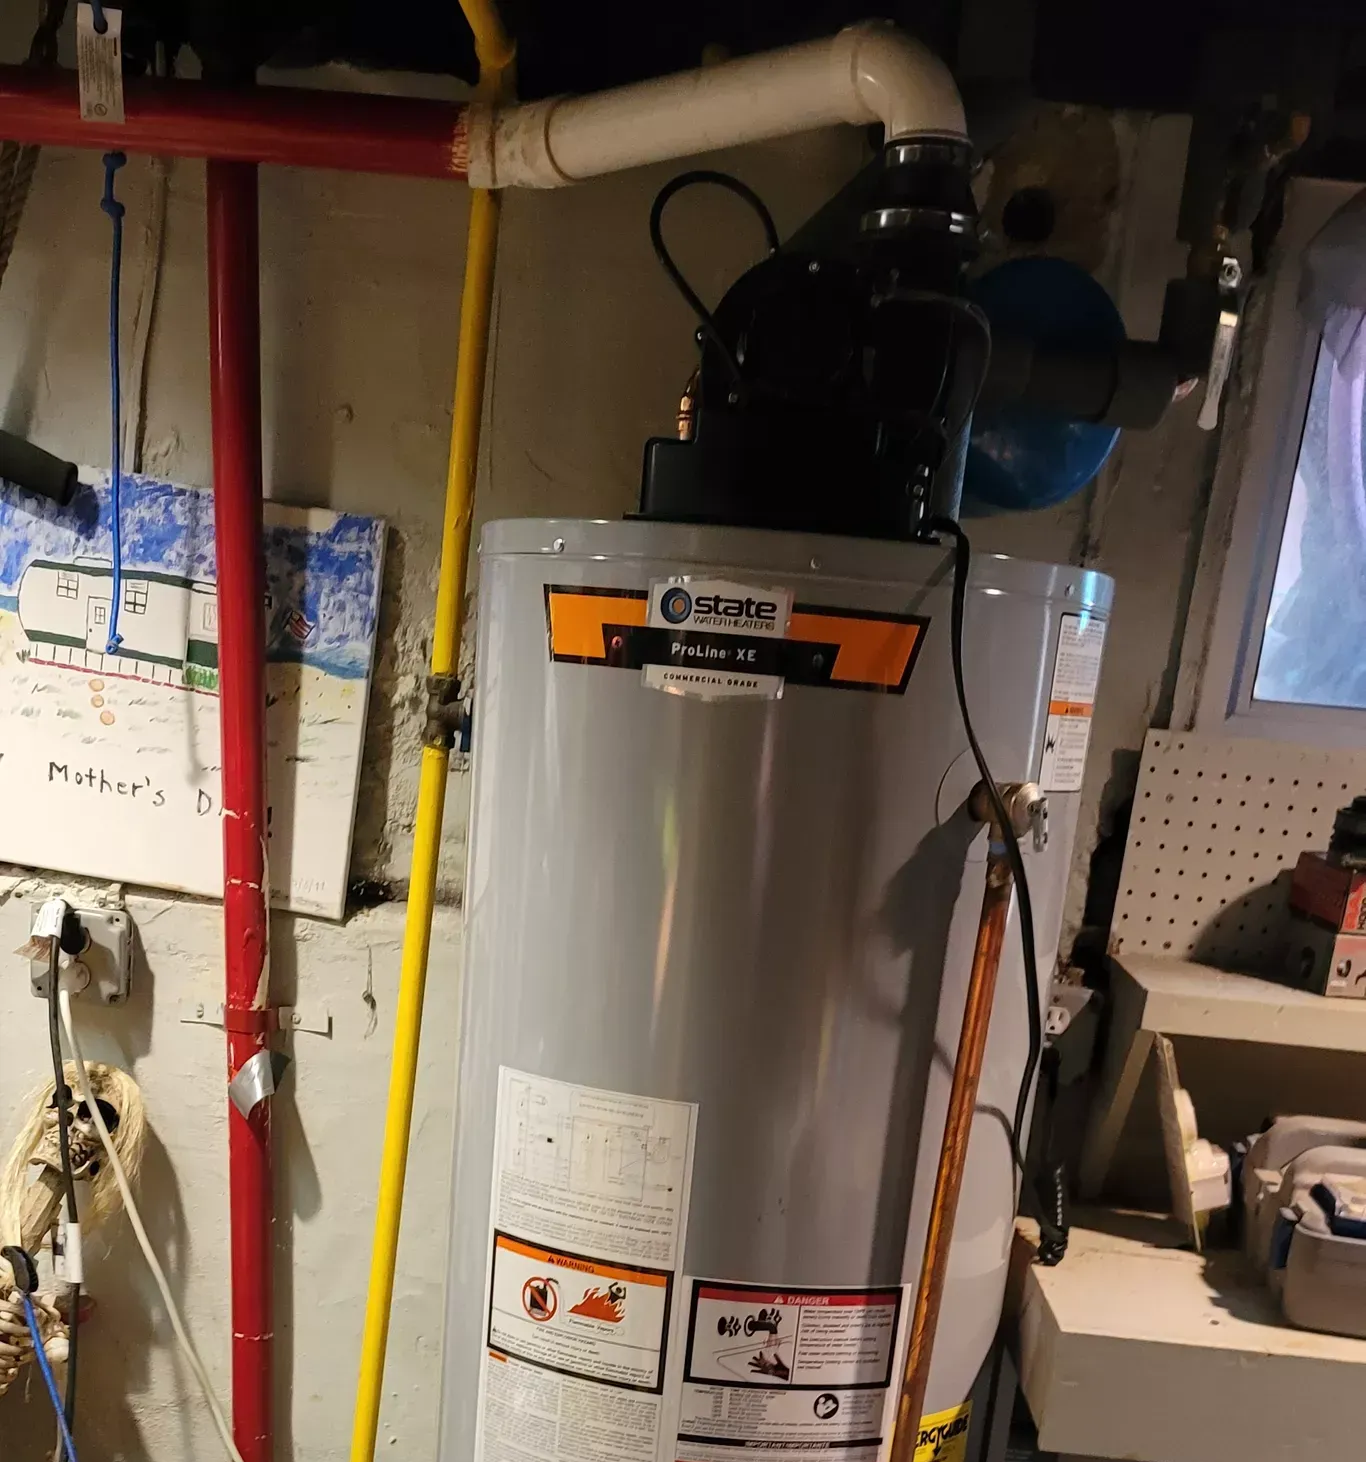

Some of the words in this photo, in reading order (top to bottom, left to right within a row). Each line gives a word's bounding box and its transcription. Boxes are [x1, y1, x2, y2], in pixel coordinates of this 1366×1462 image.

[694, 595, 777, 620] state
[693, 615, 726, 627] WATER
[727, 618, 775, 631] HEATERS
[671, 642, 726, 660] ProLine
[736, 648, 757, 662] XE
[663, 672, 723, 687] COMMERCIAL
[727, 678, 759, 689] GRADE
[48, 761, 166, 807] Mother's
[556, 1257, 595, 1274] WARNING
[787, 1296, 830, 1306] DANGER
